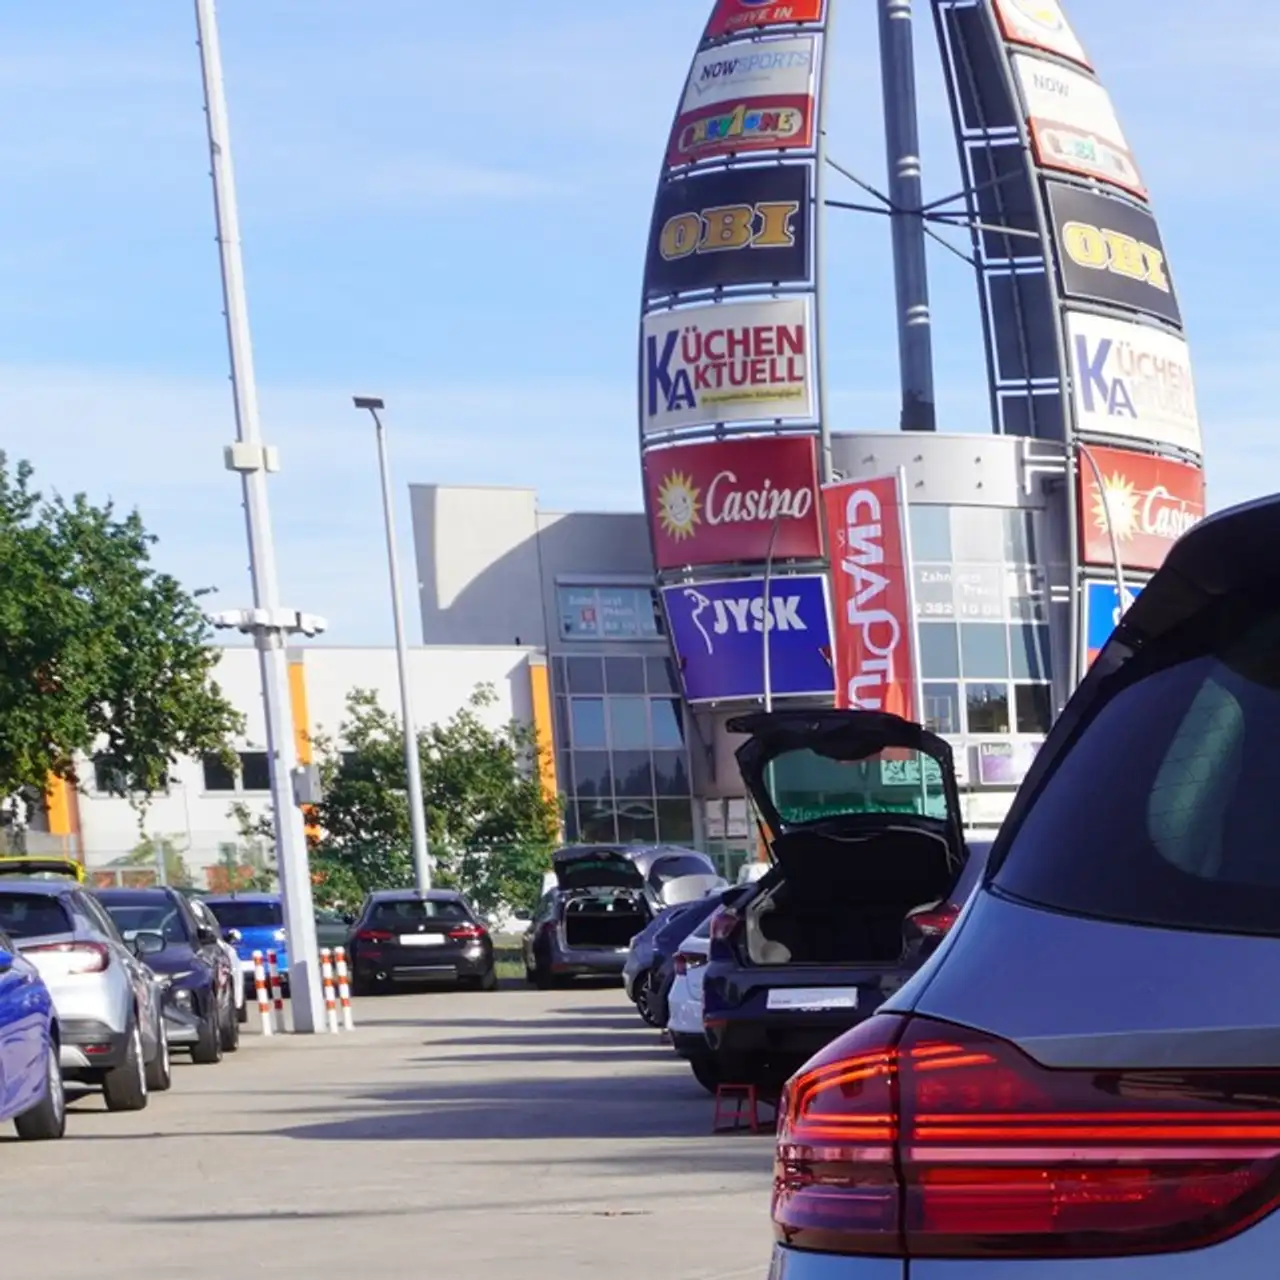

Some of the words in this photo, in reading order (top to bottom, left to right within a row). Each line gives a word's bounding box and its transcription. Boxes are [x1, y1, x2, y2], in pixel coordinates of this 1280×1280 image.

[773, 7, 794, 19] IN
[659, 200, 799, 261] OBI
[1062, 221, 1170, 293] OBI
[647, 324, 804, 416] KÜCHEN
[667, 356, 804, 411] AKTUELL
[705, 470, 812, 526] Casino
[713, 595, 808, 634] JYSK
